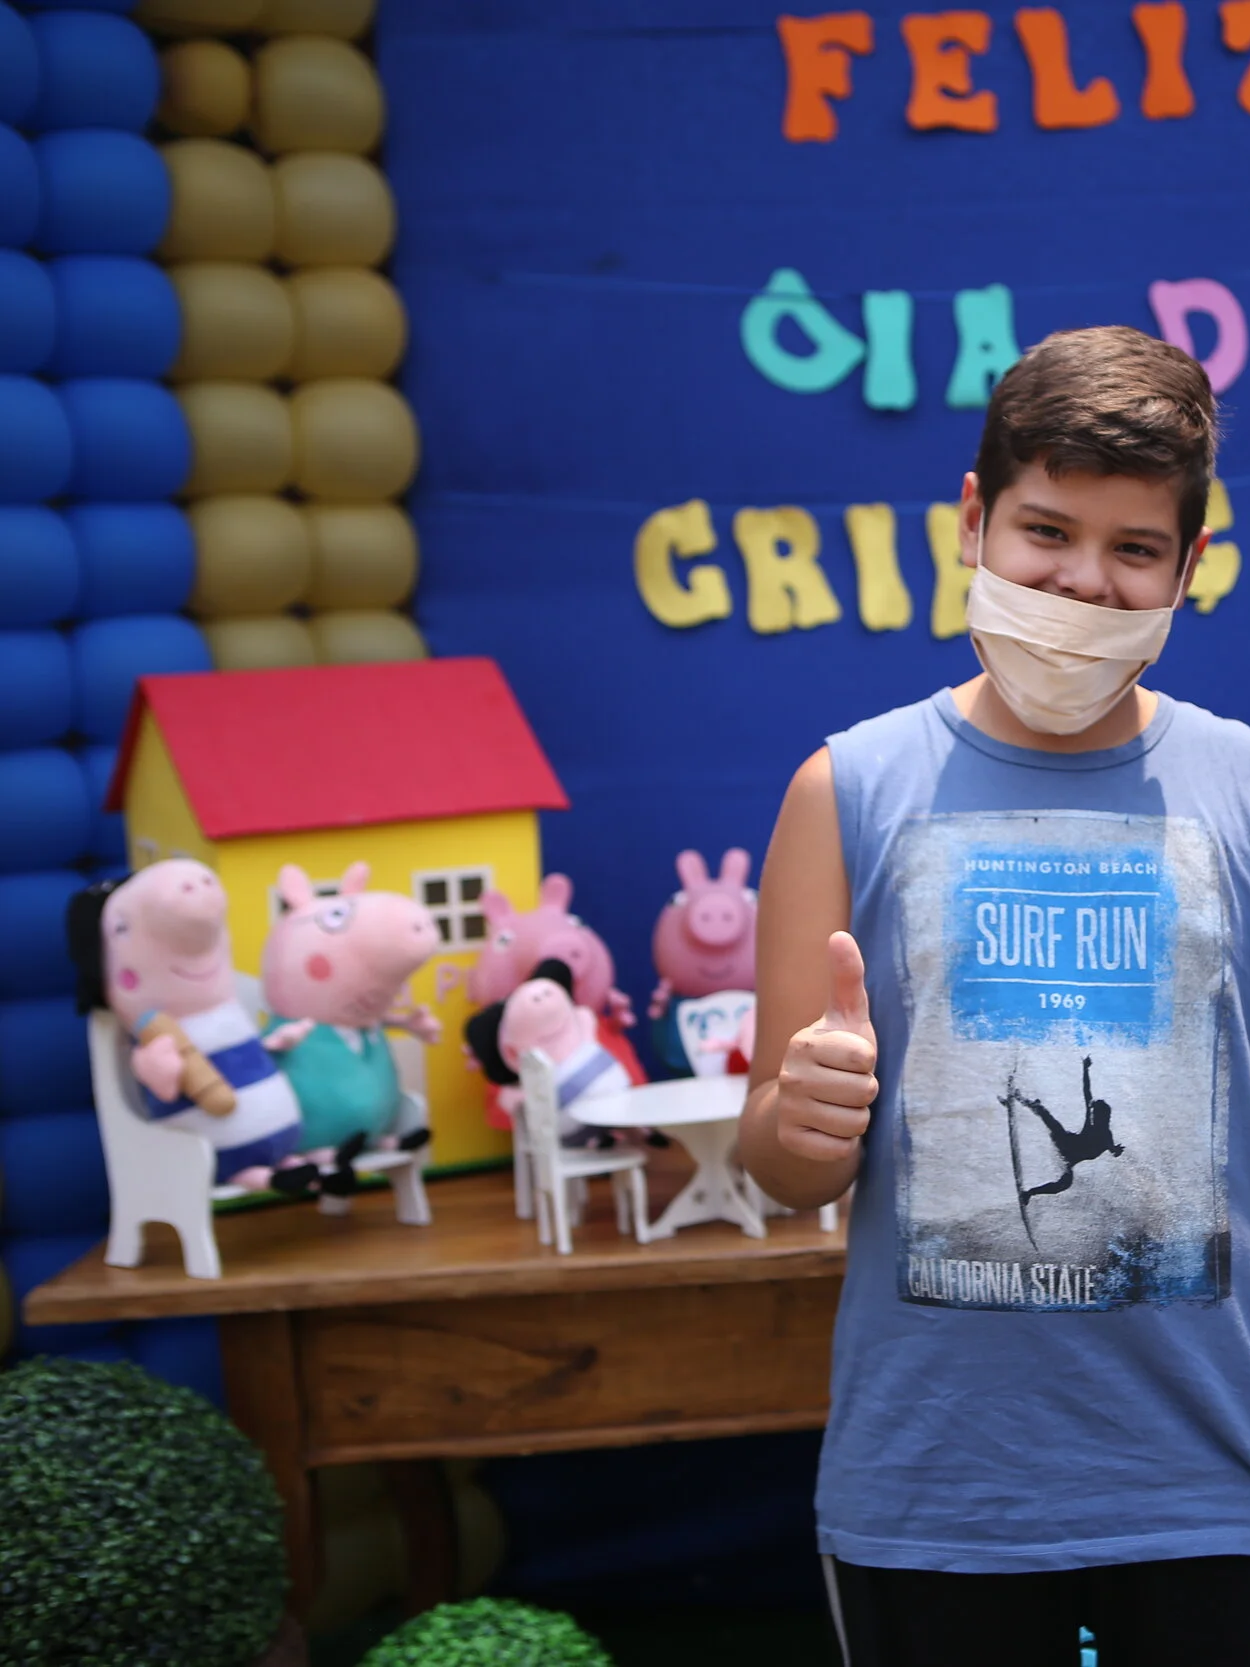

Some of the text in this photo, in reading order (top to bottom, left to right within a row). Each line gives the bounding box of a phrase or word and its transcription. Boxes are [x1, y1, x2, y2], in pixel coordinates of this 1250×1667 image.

[964, 859, 1158, 875] HUNTINGTON BEACH
[976, 902, 1147, 970] SURF RUN
[1038, 993, 1086, 1010] 1969
[908, 1254, 1098, 1305] CALIFORNIA STATE
